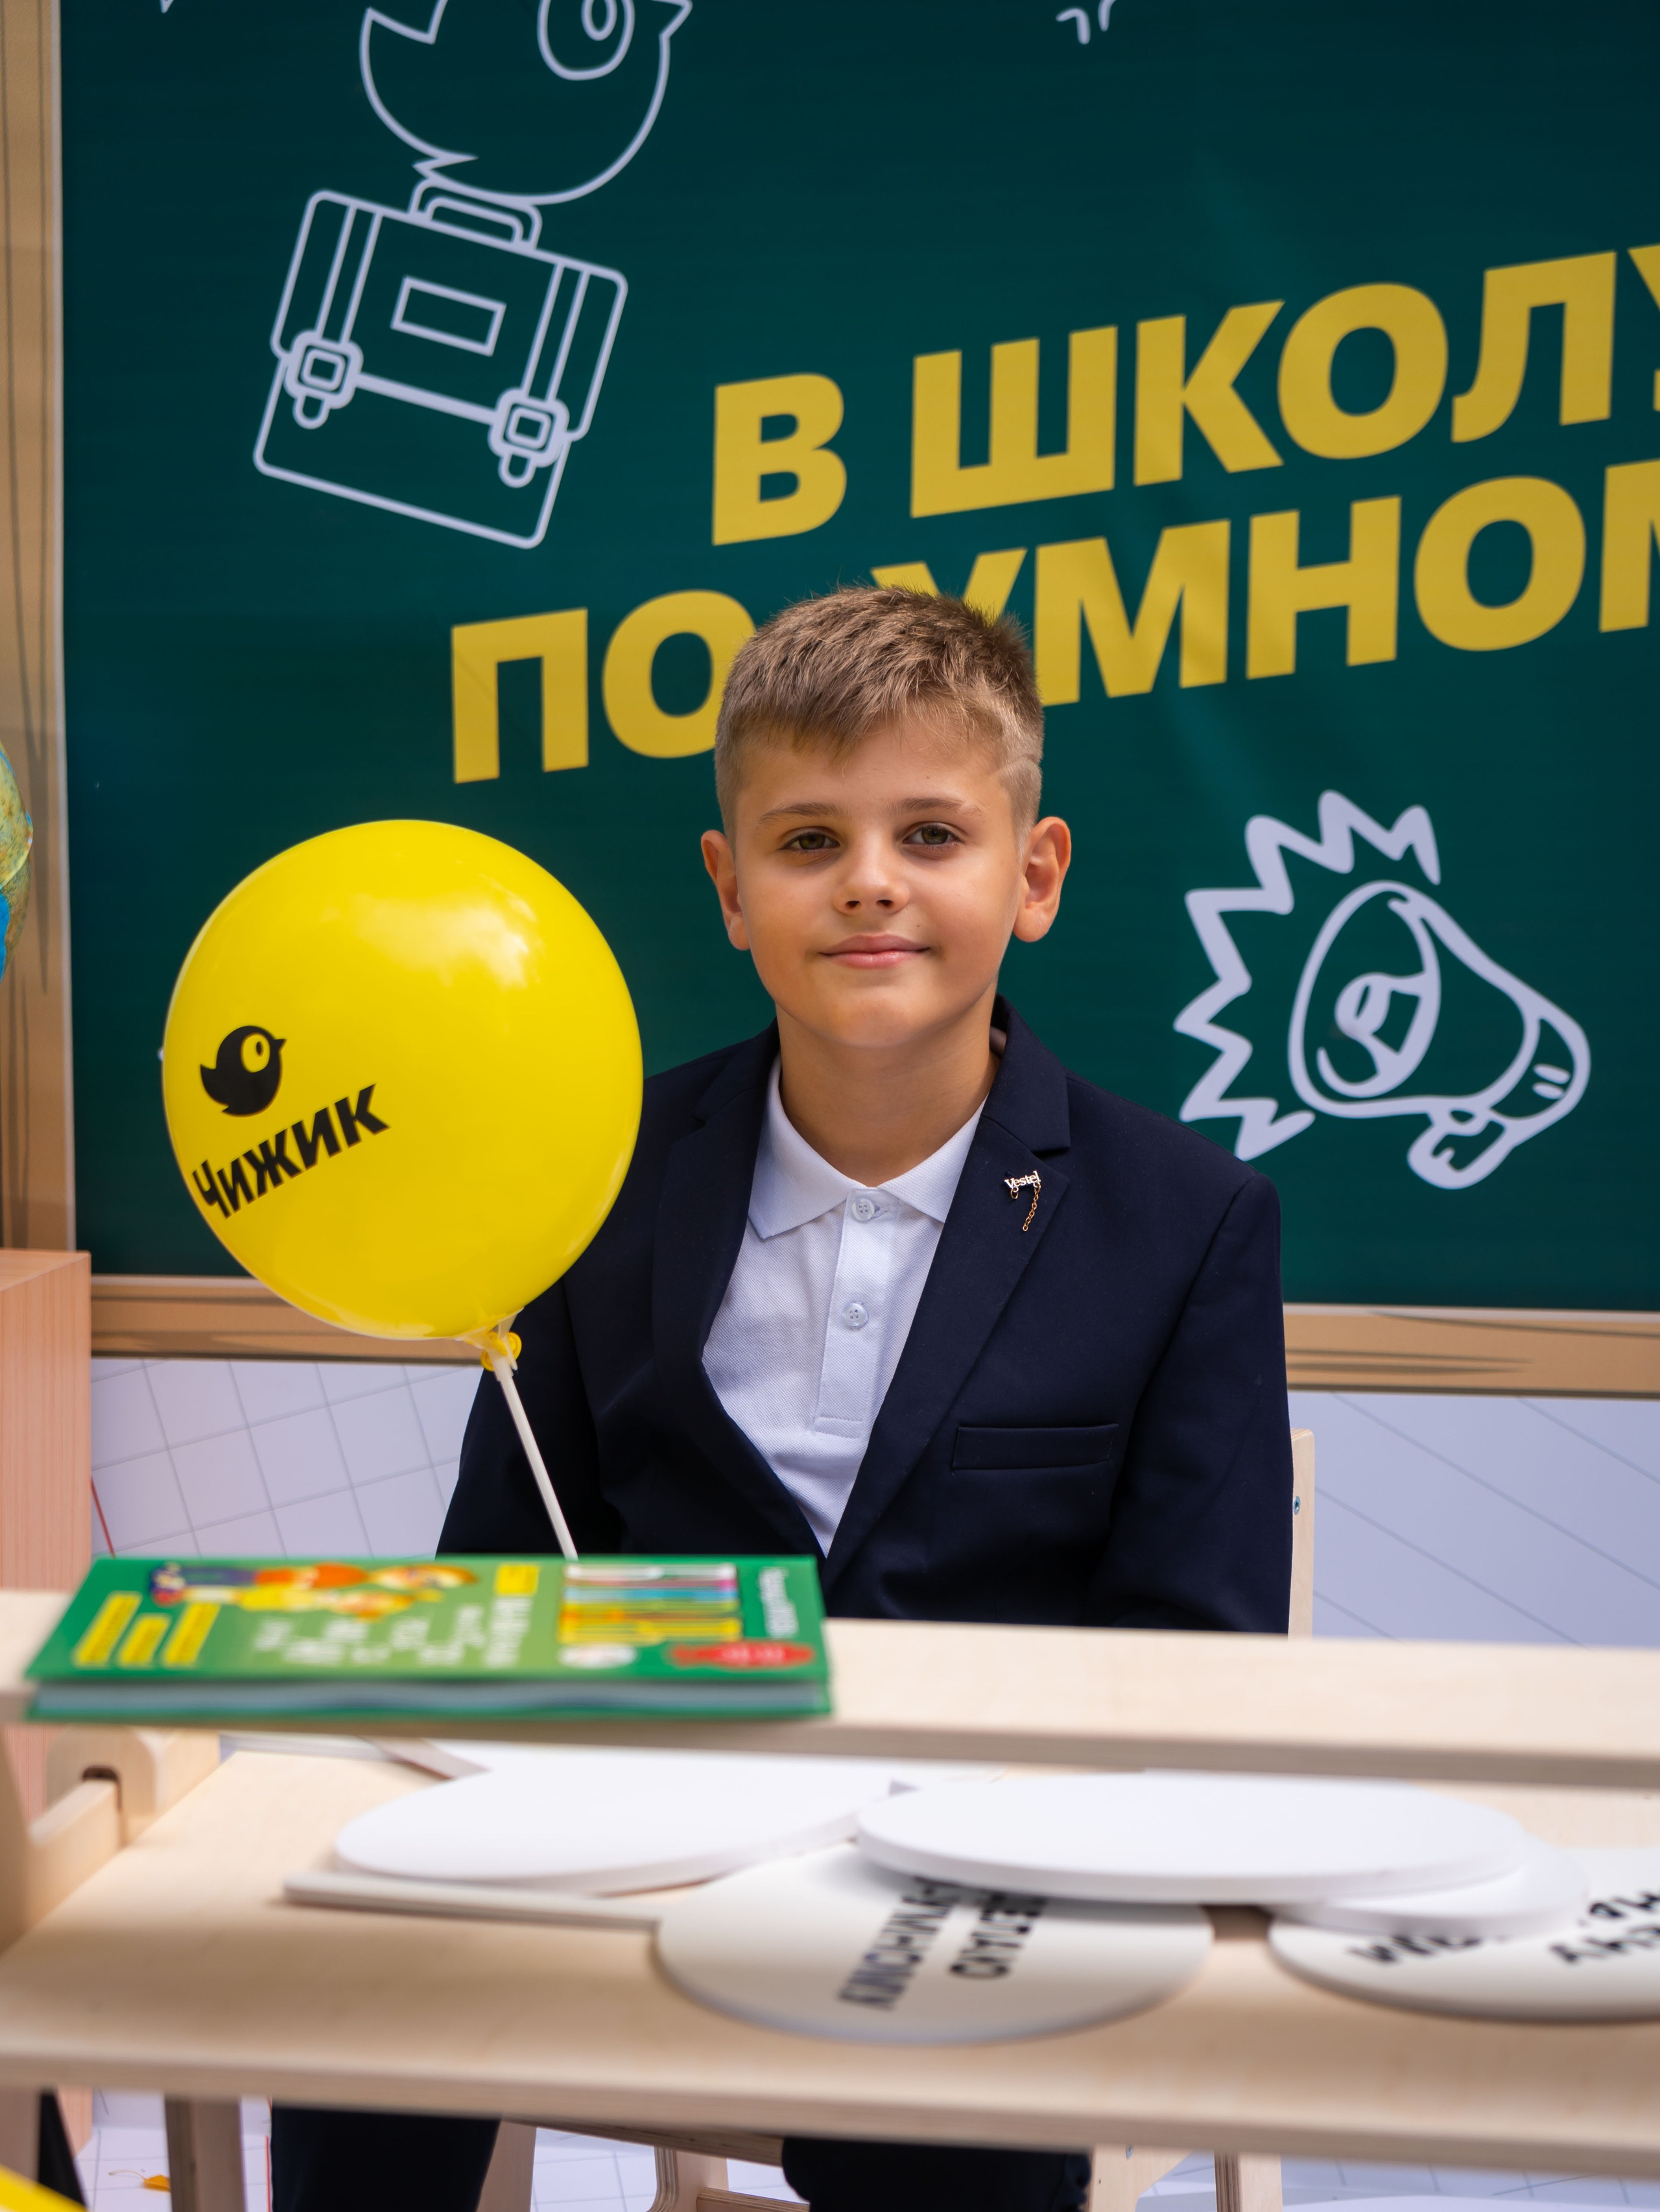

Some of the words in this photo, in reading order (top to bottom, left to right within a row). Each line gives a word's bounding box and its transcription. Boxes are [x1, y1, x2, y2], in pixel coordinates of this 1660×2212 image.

[712, 372, 847, 545] В
[910, 244, 1660, 519] ШКОЛ
[451, 589, 757, 784] ПО
[1004, 1170, 1042, 1189] Vestel
